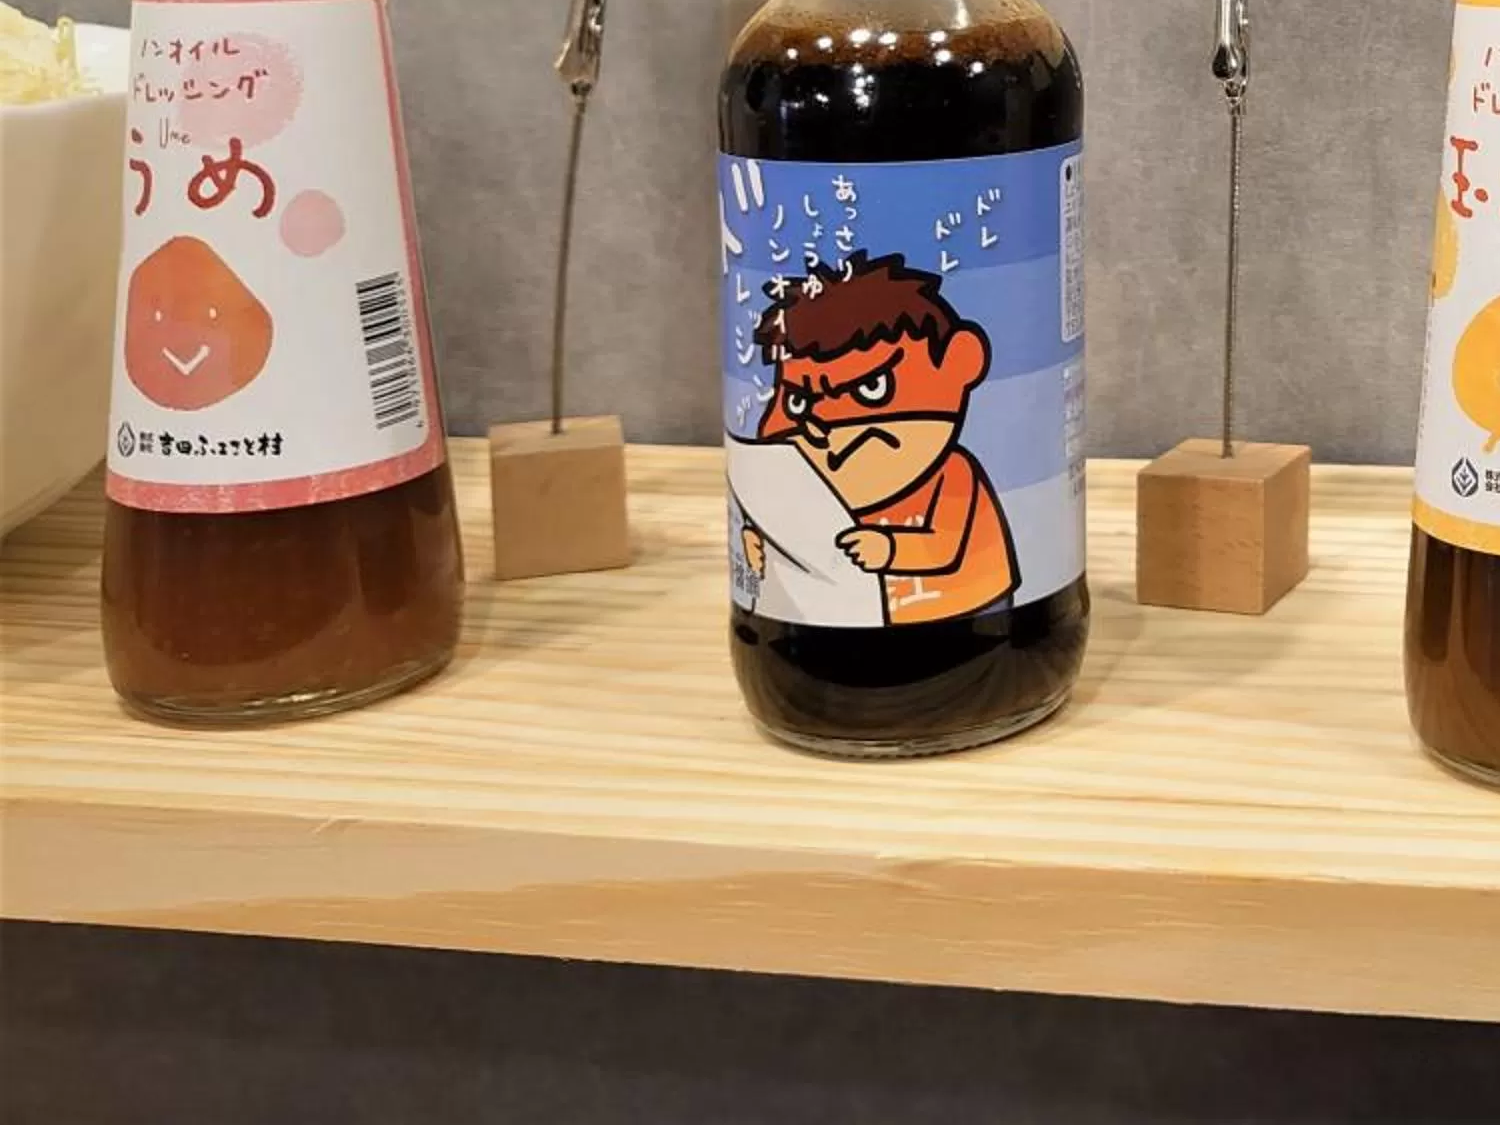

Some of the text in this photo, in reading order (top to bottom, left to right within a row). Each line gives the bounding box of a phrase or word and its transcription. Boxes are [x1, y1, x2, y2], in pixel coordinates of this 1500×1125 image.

[133, 69, 268, 102] ドレッシング
[140, 37, 241, 64] ノンオイル
[159, 118, 191, 148] Ume
[130, 128, 275, 218] うめ
[801, 195, 824, 300] しょうゆ
[832, 175, 857, 282] あっさり
[934, 212, 962, 273] ドレ
[976, 188, 1001, 249] ドレ
[720, 160, 776, 430] ドレッシング
[768, 204, 792, 362] ノンオイル
